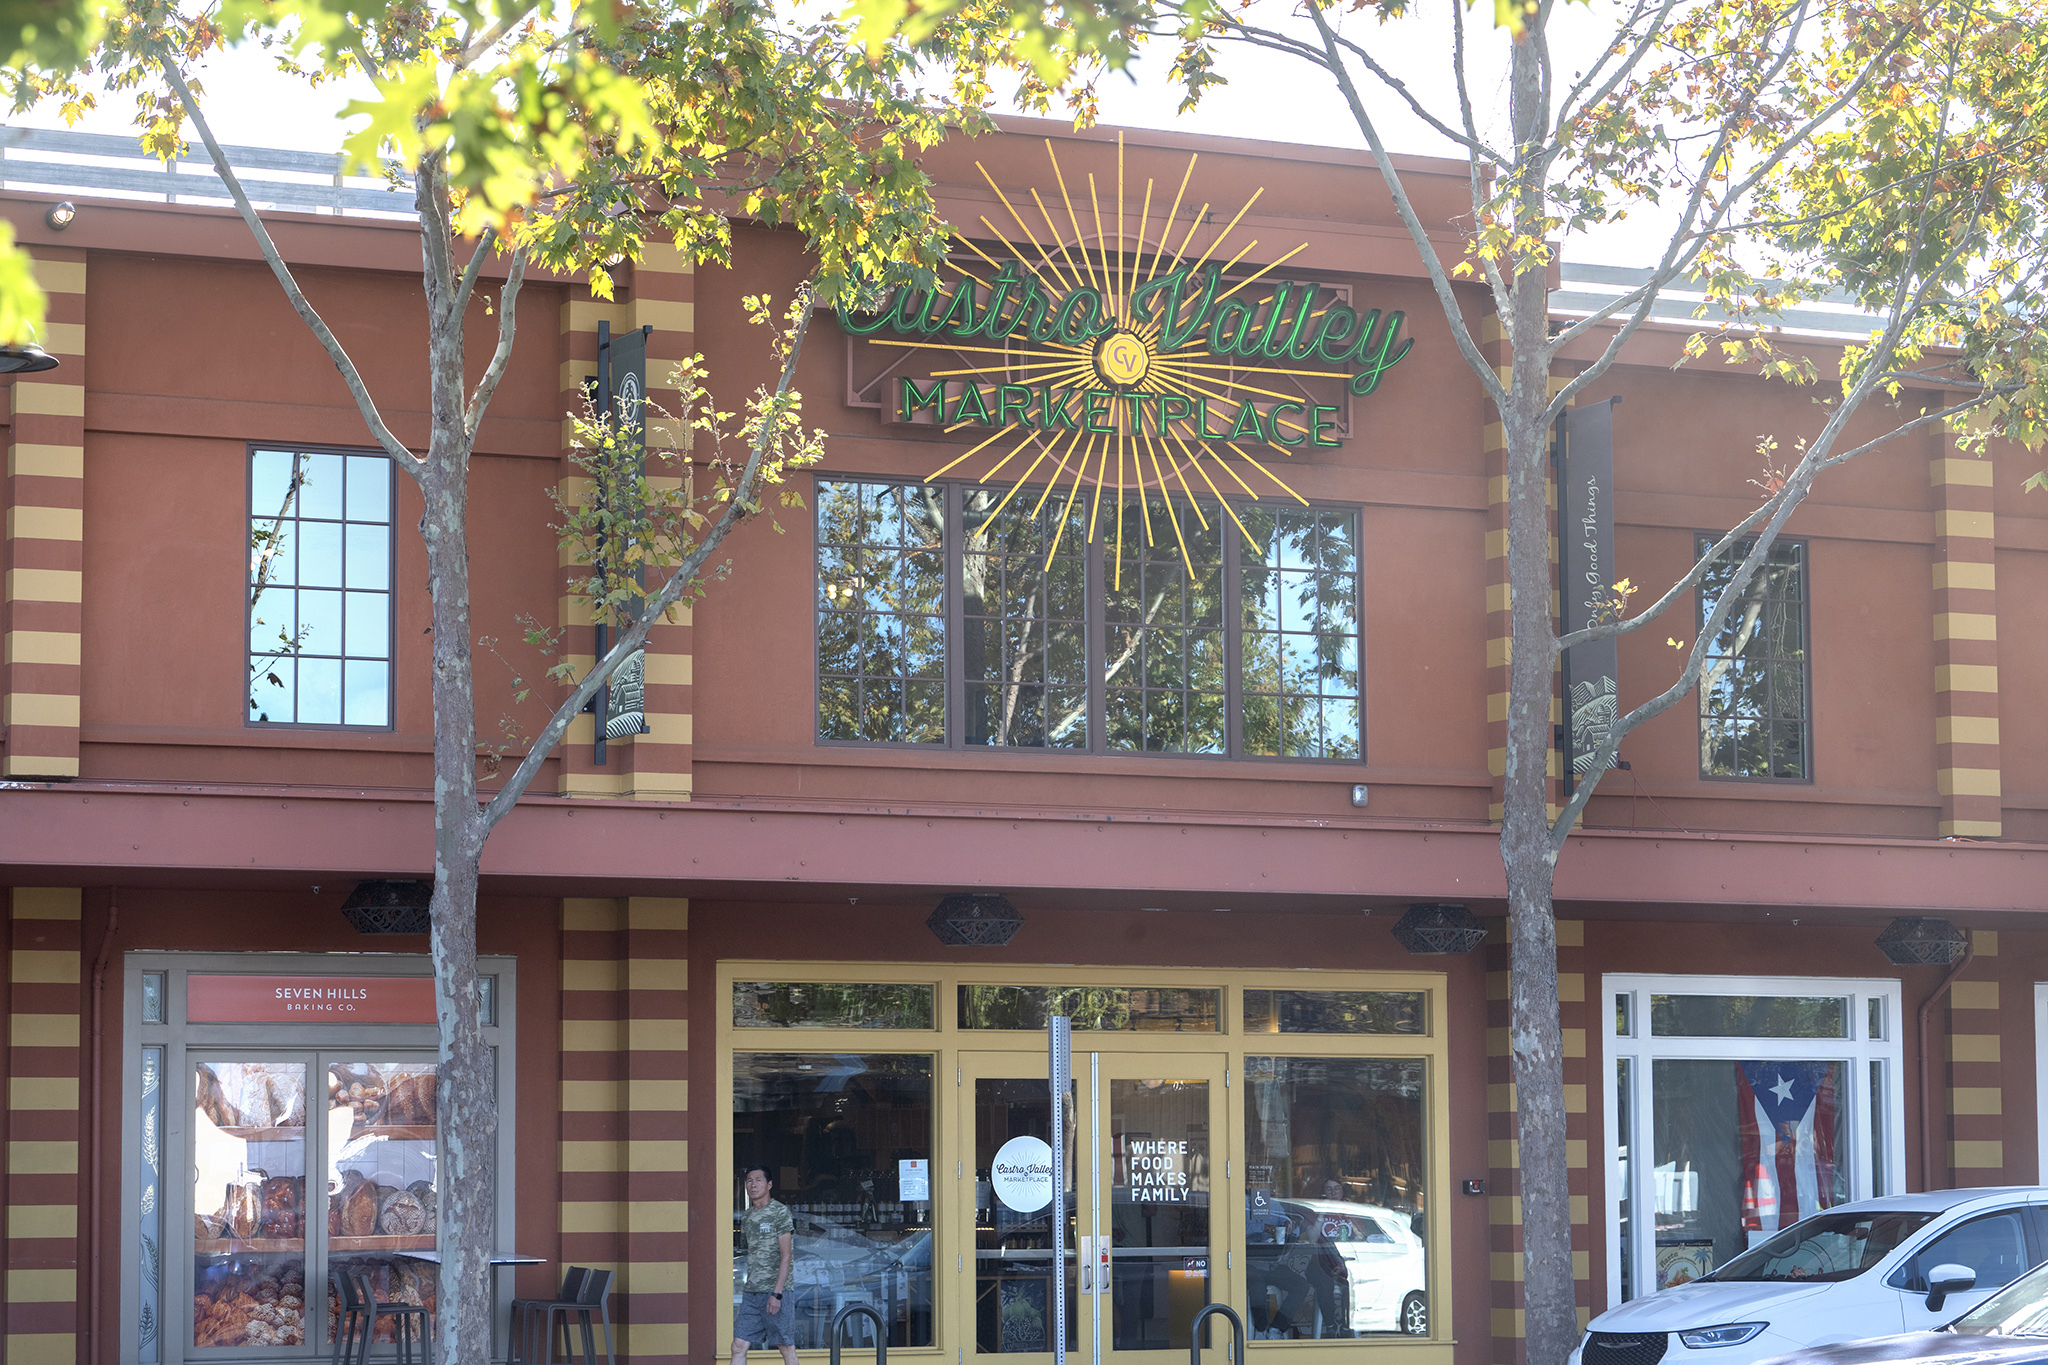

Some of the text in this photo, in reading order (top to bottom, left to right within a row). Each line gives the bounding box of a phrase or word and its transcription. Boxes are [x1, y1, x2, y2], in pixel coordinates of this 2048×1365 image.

[1130, 260, 1415, 397] Valley
[1113, 345, 1137, 372] CV
[898, 376, 1343, 448] MARKETPLACE
[1581, 474, 1600, 538] Things
[1584, 539, 1601, 585] Good
[275, 987, 368, 1000] SEVEN HILLS
[287, 1003, 357, 1012] BAKING CO.
[1130, 1140, 1189, 1155] WHERE
[996, 1163, 1025, 1174] Castro
[1130, 1156, 1174, 1171] FOOD
[1130, 1172, 1188, 1187] MAKES
[1130, 1187, 1191, 1202] FAMILY
[1195, 1260, 1207, 1268] NO
